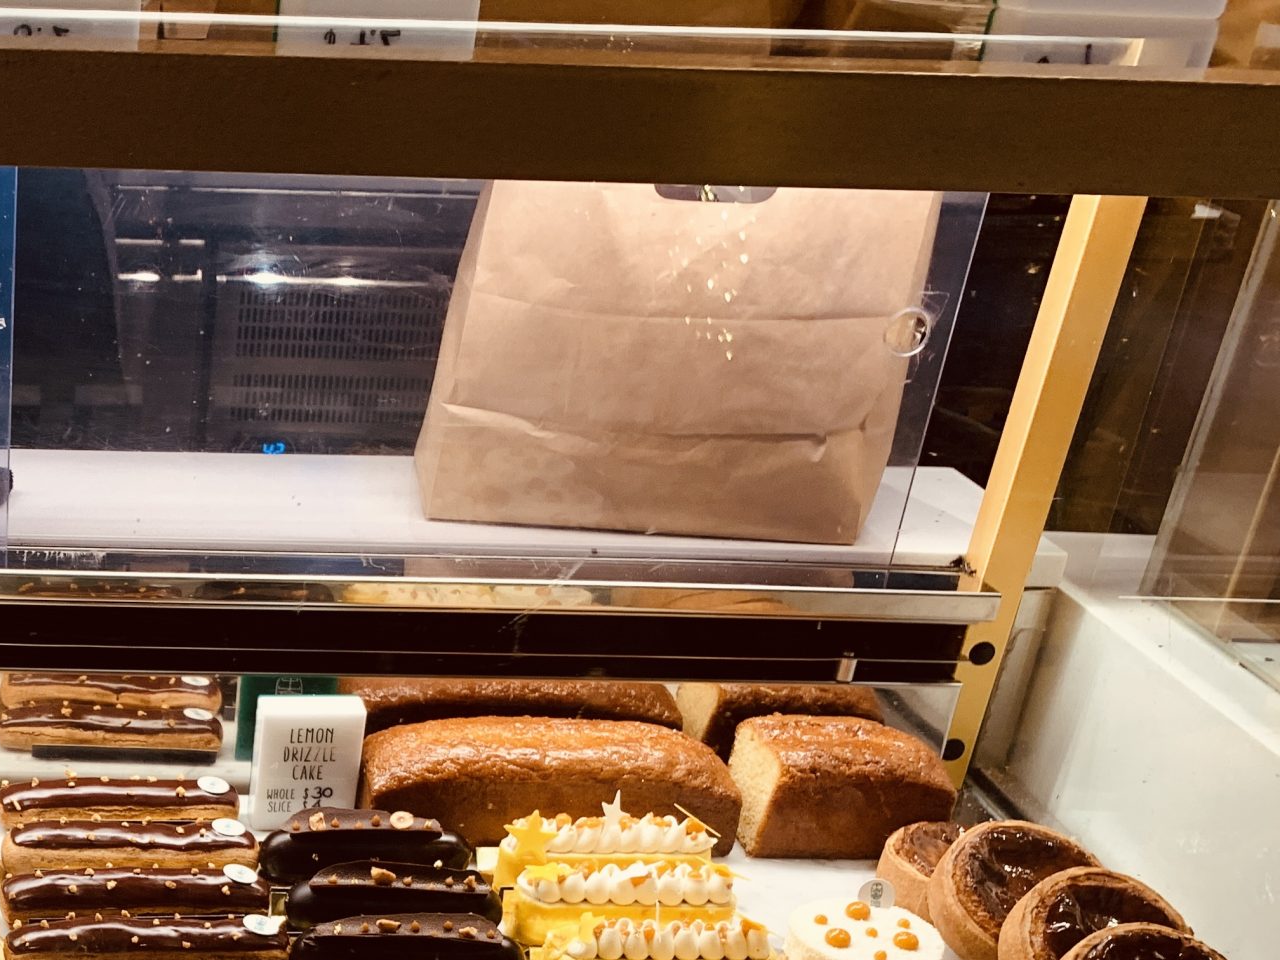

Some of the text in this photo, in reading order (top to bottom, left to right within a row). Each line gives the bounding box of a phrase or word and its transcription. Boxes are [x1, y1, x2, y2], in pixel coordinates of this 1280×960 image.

[290, 728, 334, 744] LEMON
[283, 746, 336, 763] DRIZZLE
[292, 765, 324, 780] CAKE
[266, 788, 295, 800] WHOLE
[267, 800, 291, 813] SLICE
